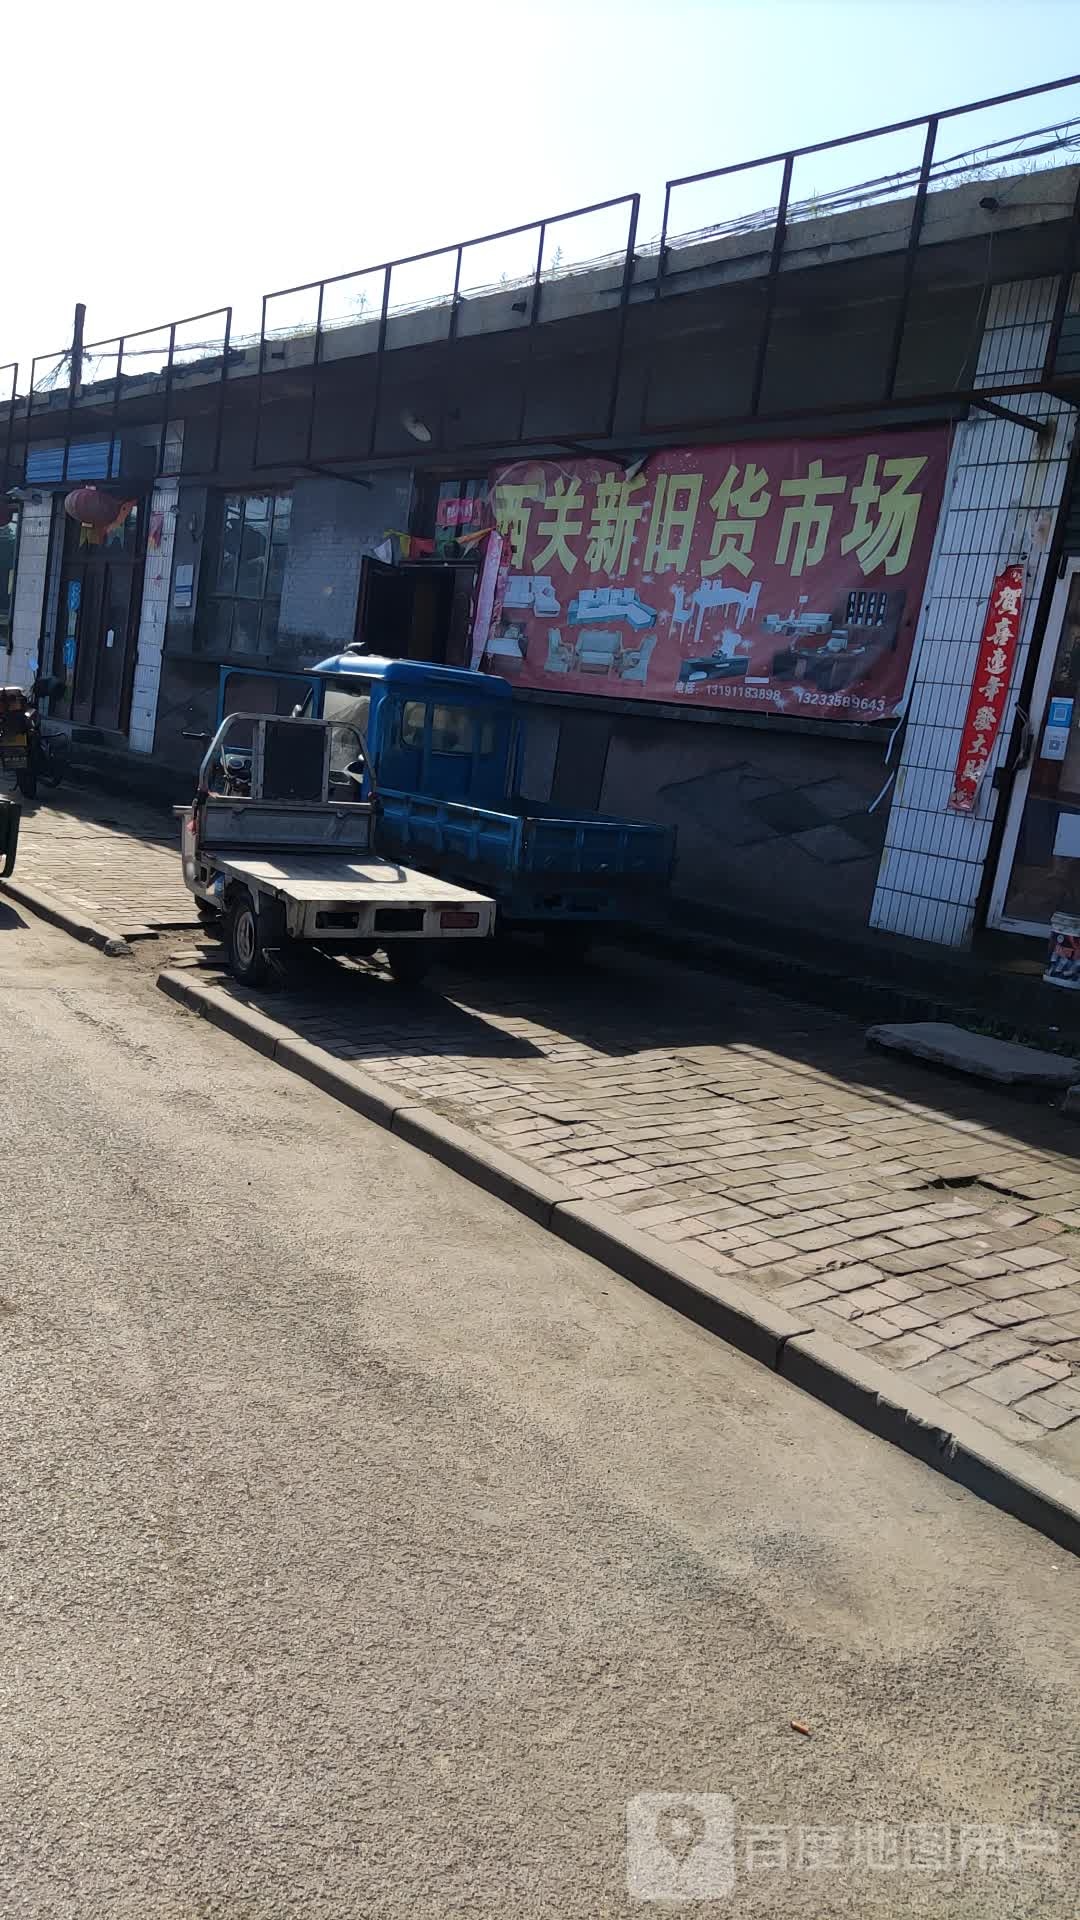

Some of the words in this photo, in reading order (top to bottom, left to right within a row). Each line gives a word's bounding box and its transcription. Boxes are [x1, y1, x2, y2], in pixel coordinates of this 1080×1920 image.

[496, 455, 928, 577] 西关新旧货市场
[706, 684, 781, 701] 13191183898
[798, 692, 885, 712] 13233589643
